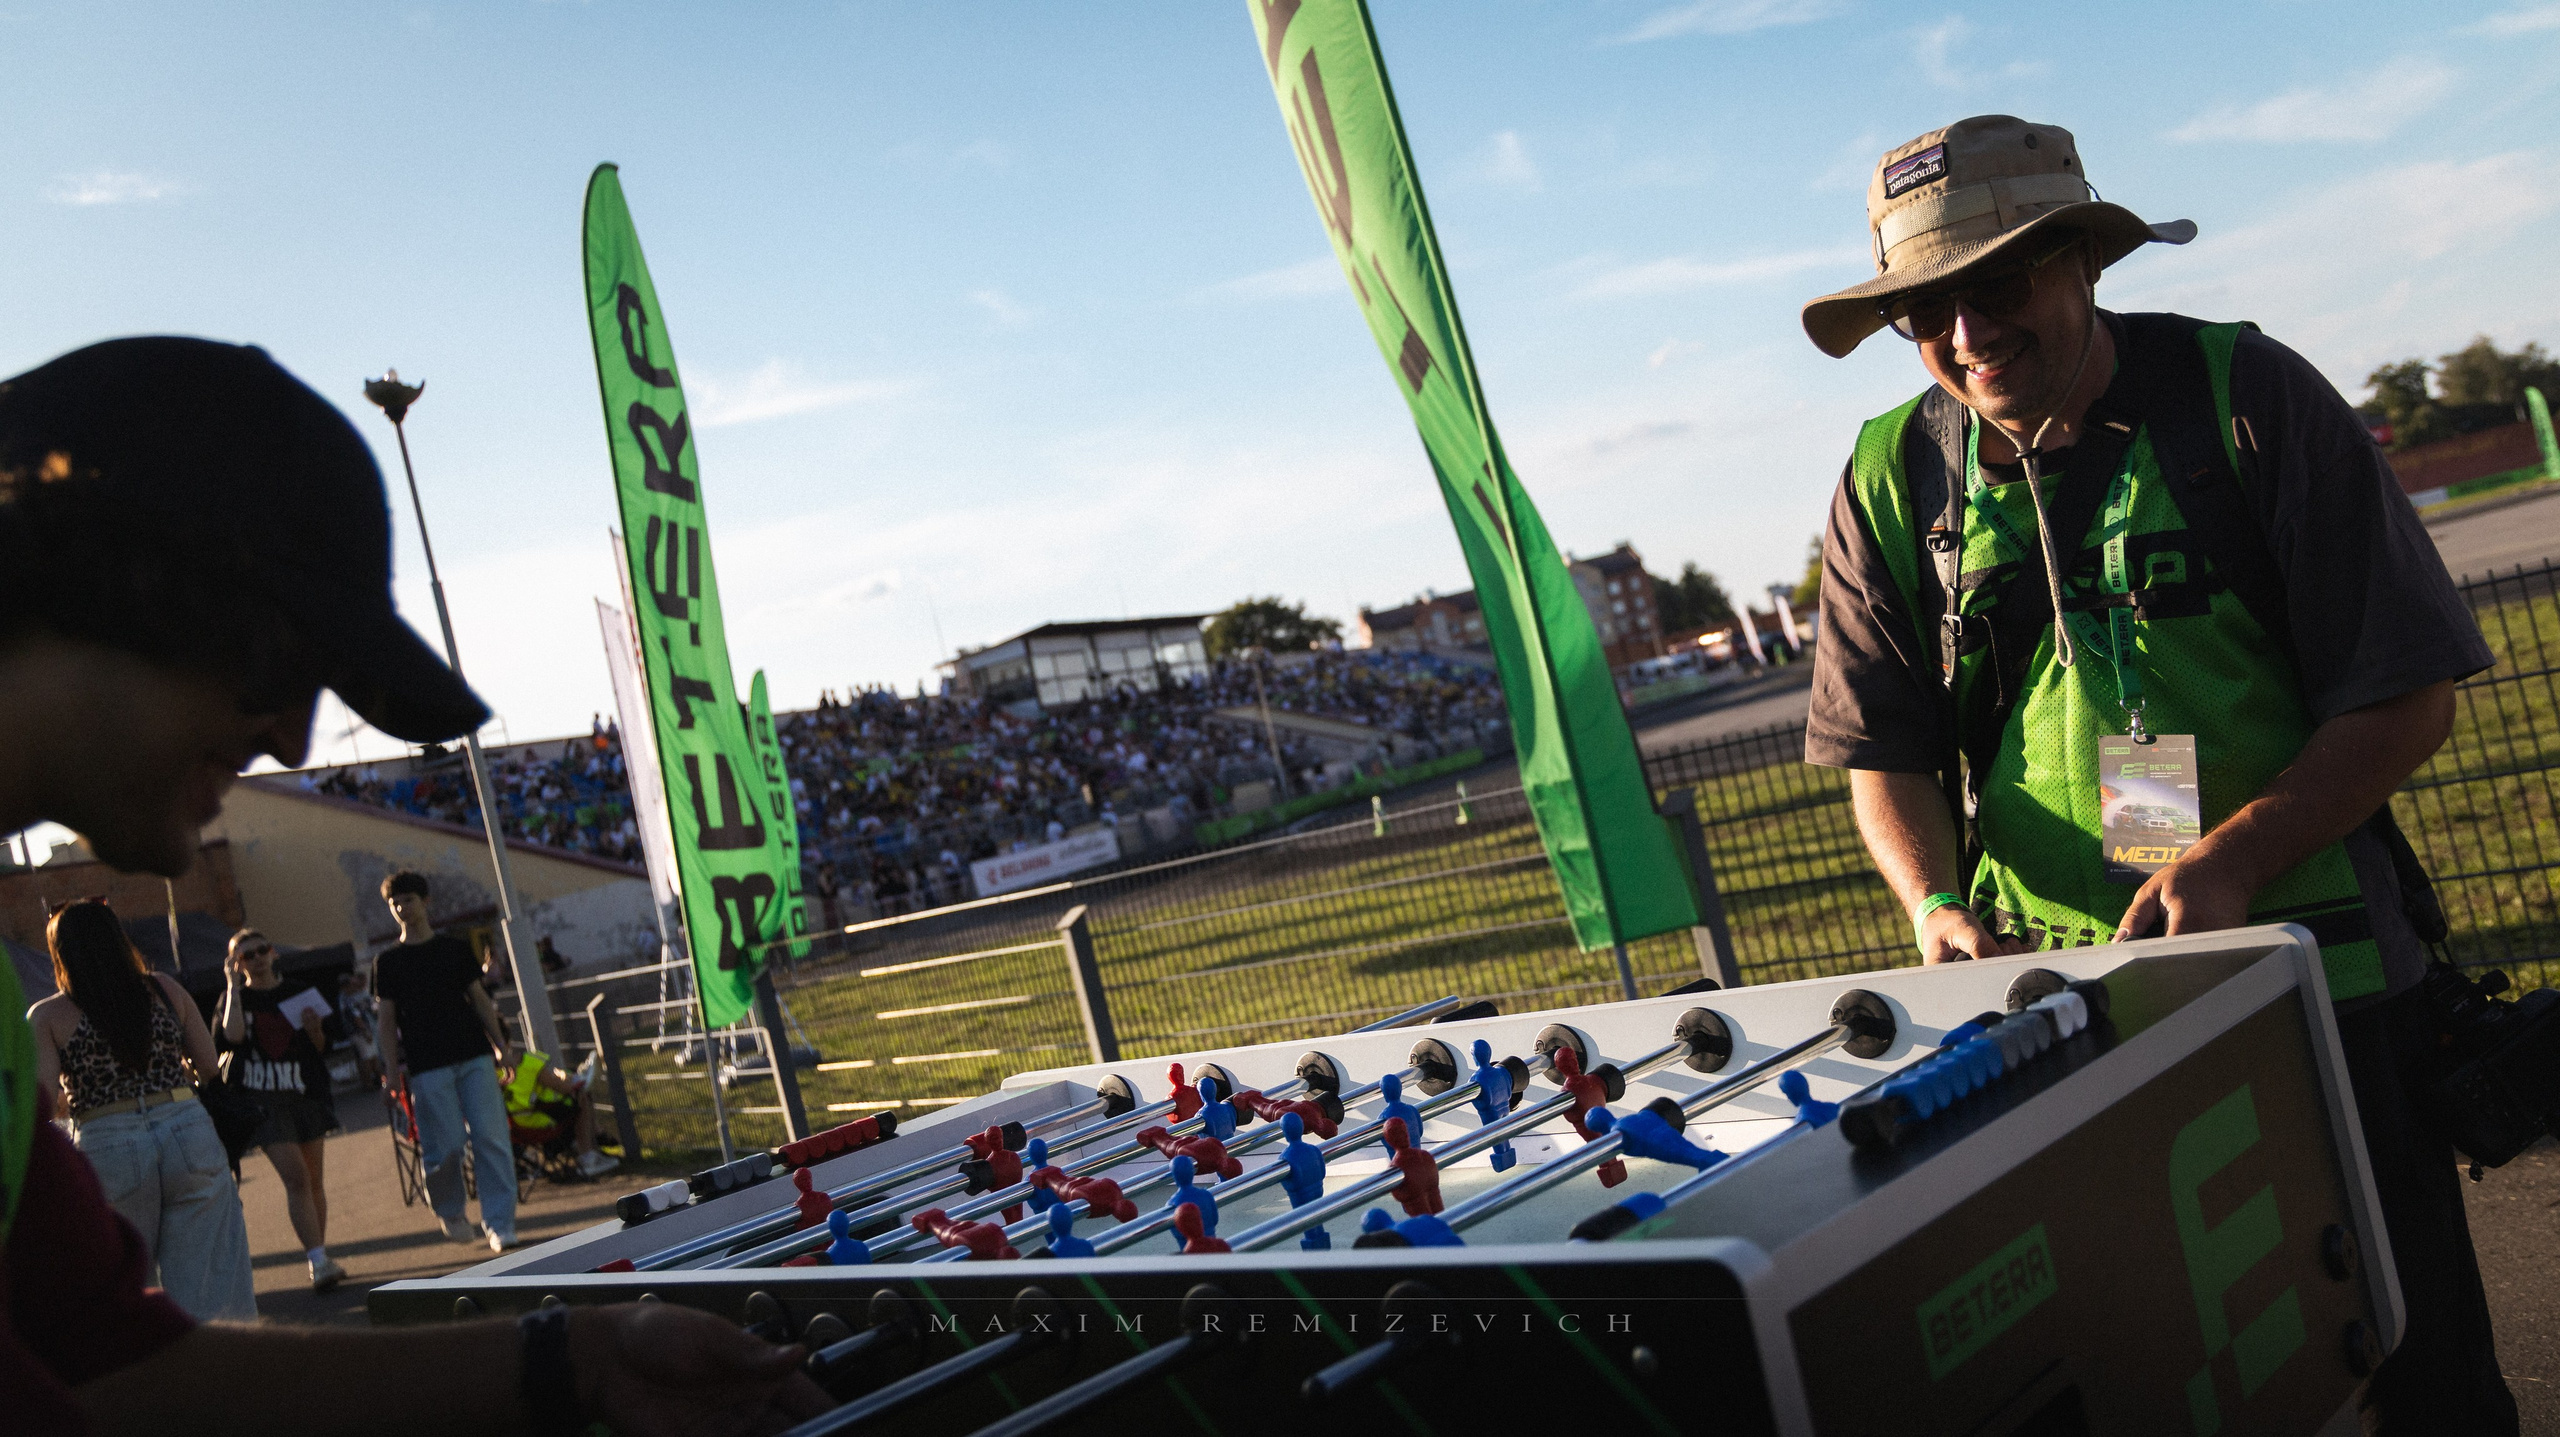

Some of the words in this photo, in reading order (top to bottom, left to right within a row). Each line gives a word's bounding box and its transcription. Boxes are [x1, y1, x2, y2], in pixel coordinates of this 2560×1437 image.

[1890, 163, 1941, 195] patagonia
[1992, 512, 2027, 553] BETERA
[2109, 537, 2122, 588] BETERA
[2117, 615, 2131, 666] BETERA
[2112, 846, 2181, 863] MEDI
[1929, 1242, 2050, 1358] BETERA
